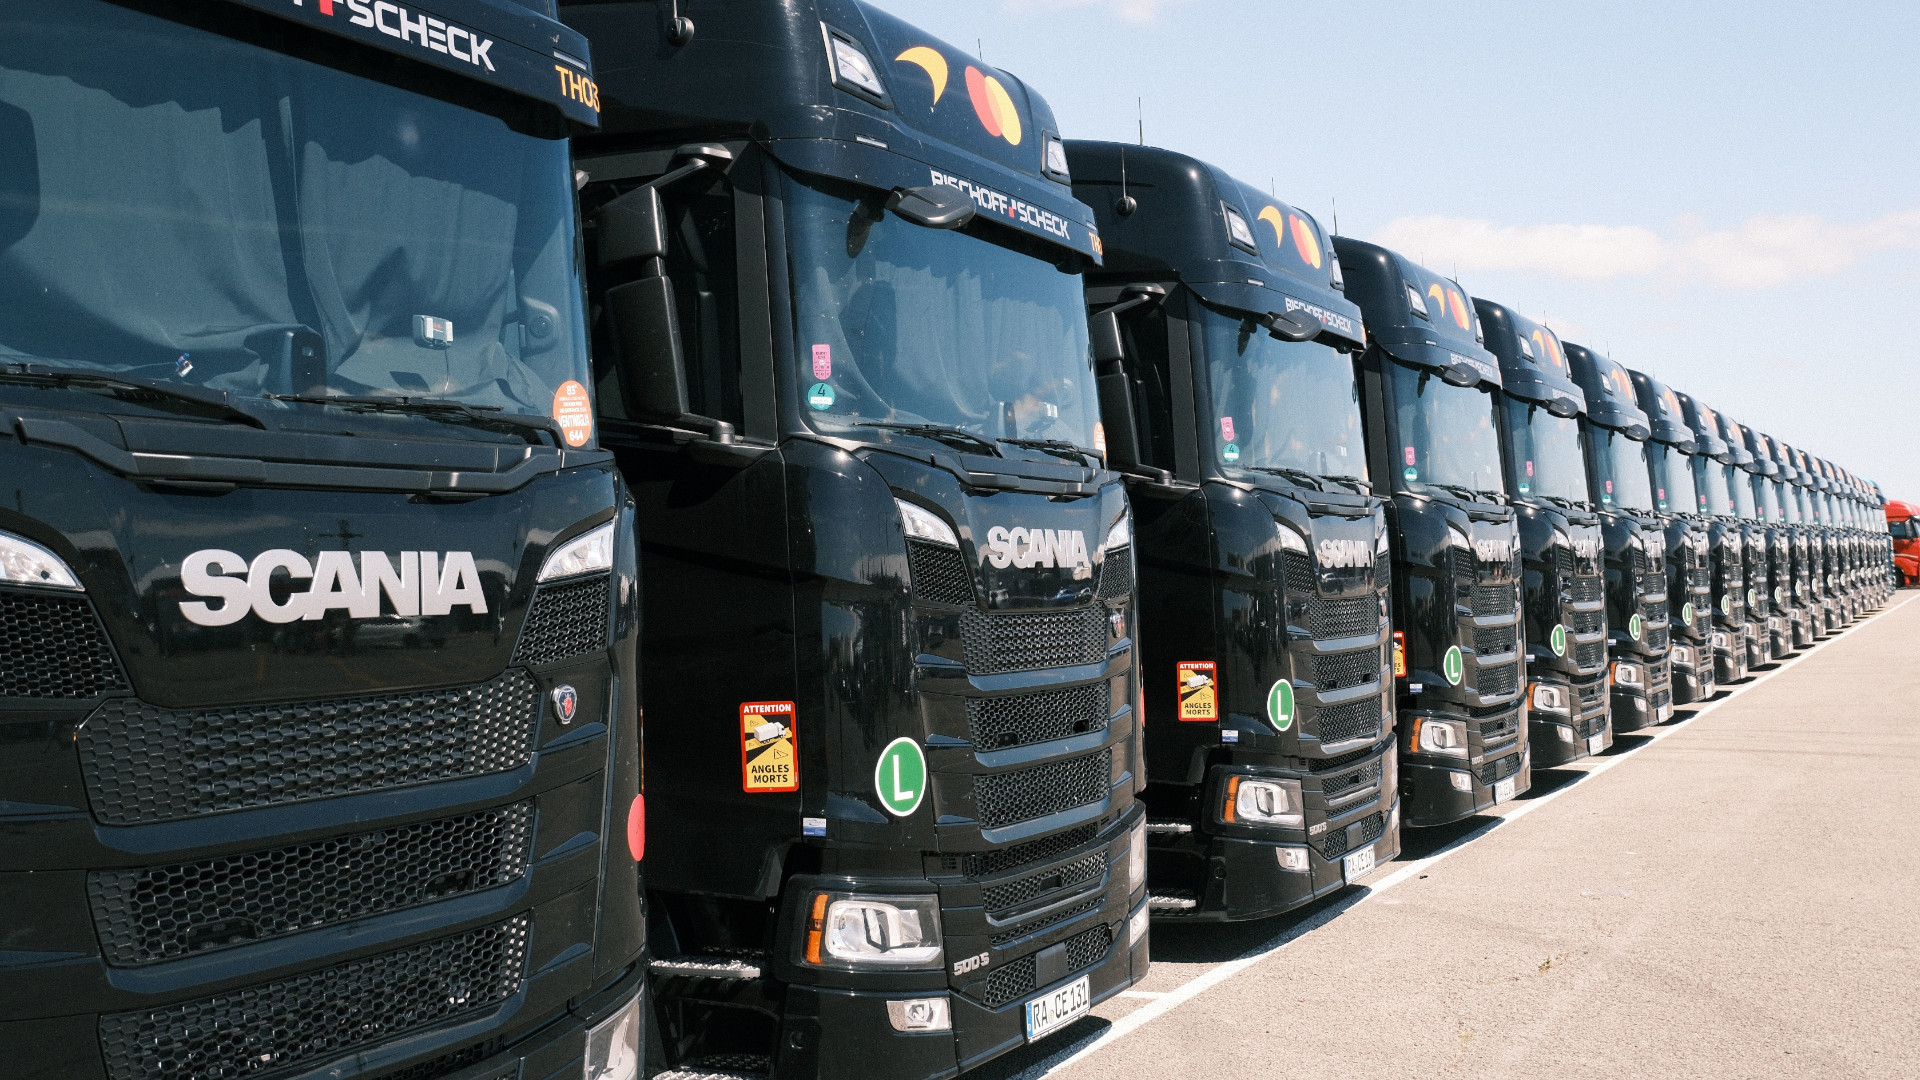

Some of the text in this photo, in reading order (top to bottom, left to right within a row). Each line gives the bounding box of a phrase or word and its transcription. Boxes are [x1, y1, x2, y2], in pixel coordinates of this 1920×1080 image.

[347, 0, 496, 72] SCHECK
[1017, 202, 1070, 240] SCHECK
[817, 384, 825, 396] 4
[569, 430, 584, 442] 644
[987, 525, 1090, 569] SCANIA
[1320, 539, 1370, 568] SCANIA
[178, 548, 489, 627] SCANIA
[1450, 653, 1458, 677] L
[744, 704, 792, 713] ATTENTION
[1277, 690, 1288, 721] L
[751, 764, 789, 774] ANGLES
[753, 774, 788, 784] MORTS
[893, 754, 914, 801] L
[1033, 981, 1088, 1030] RA CE 131
